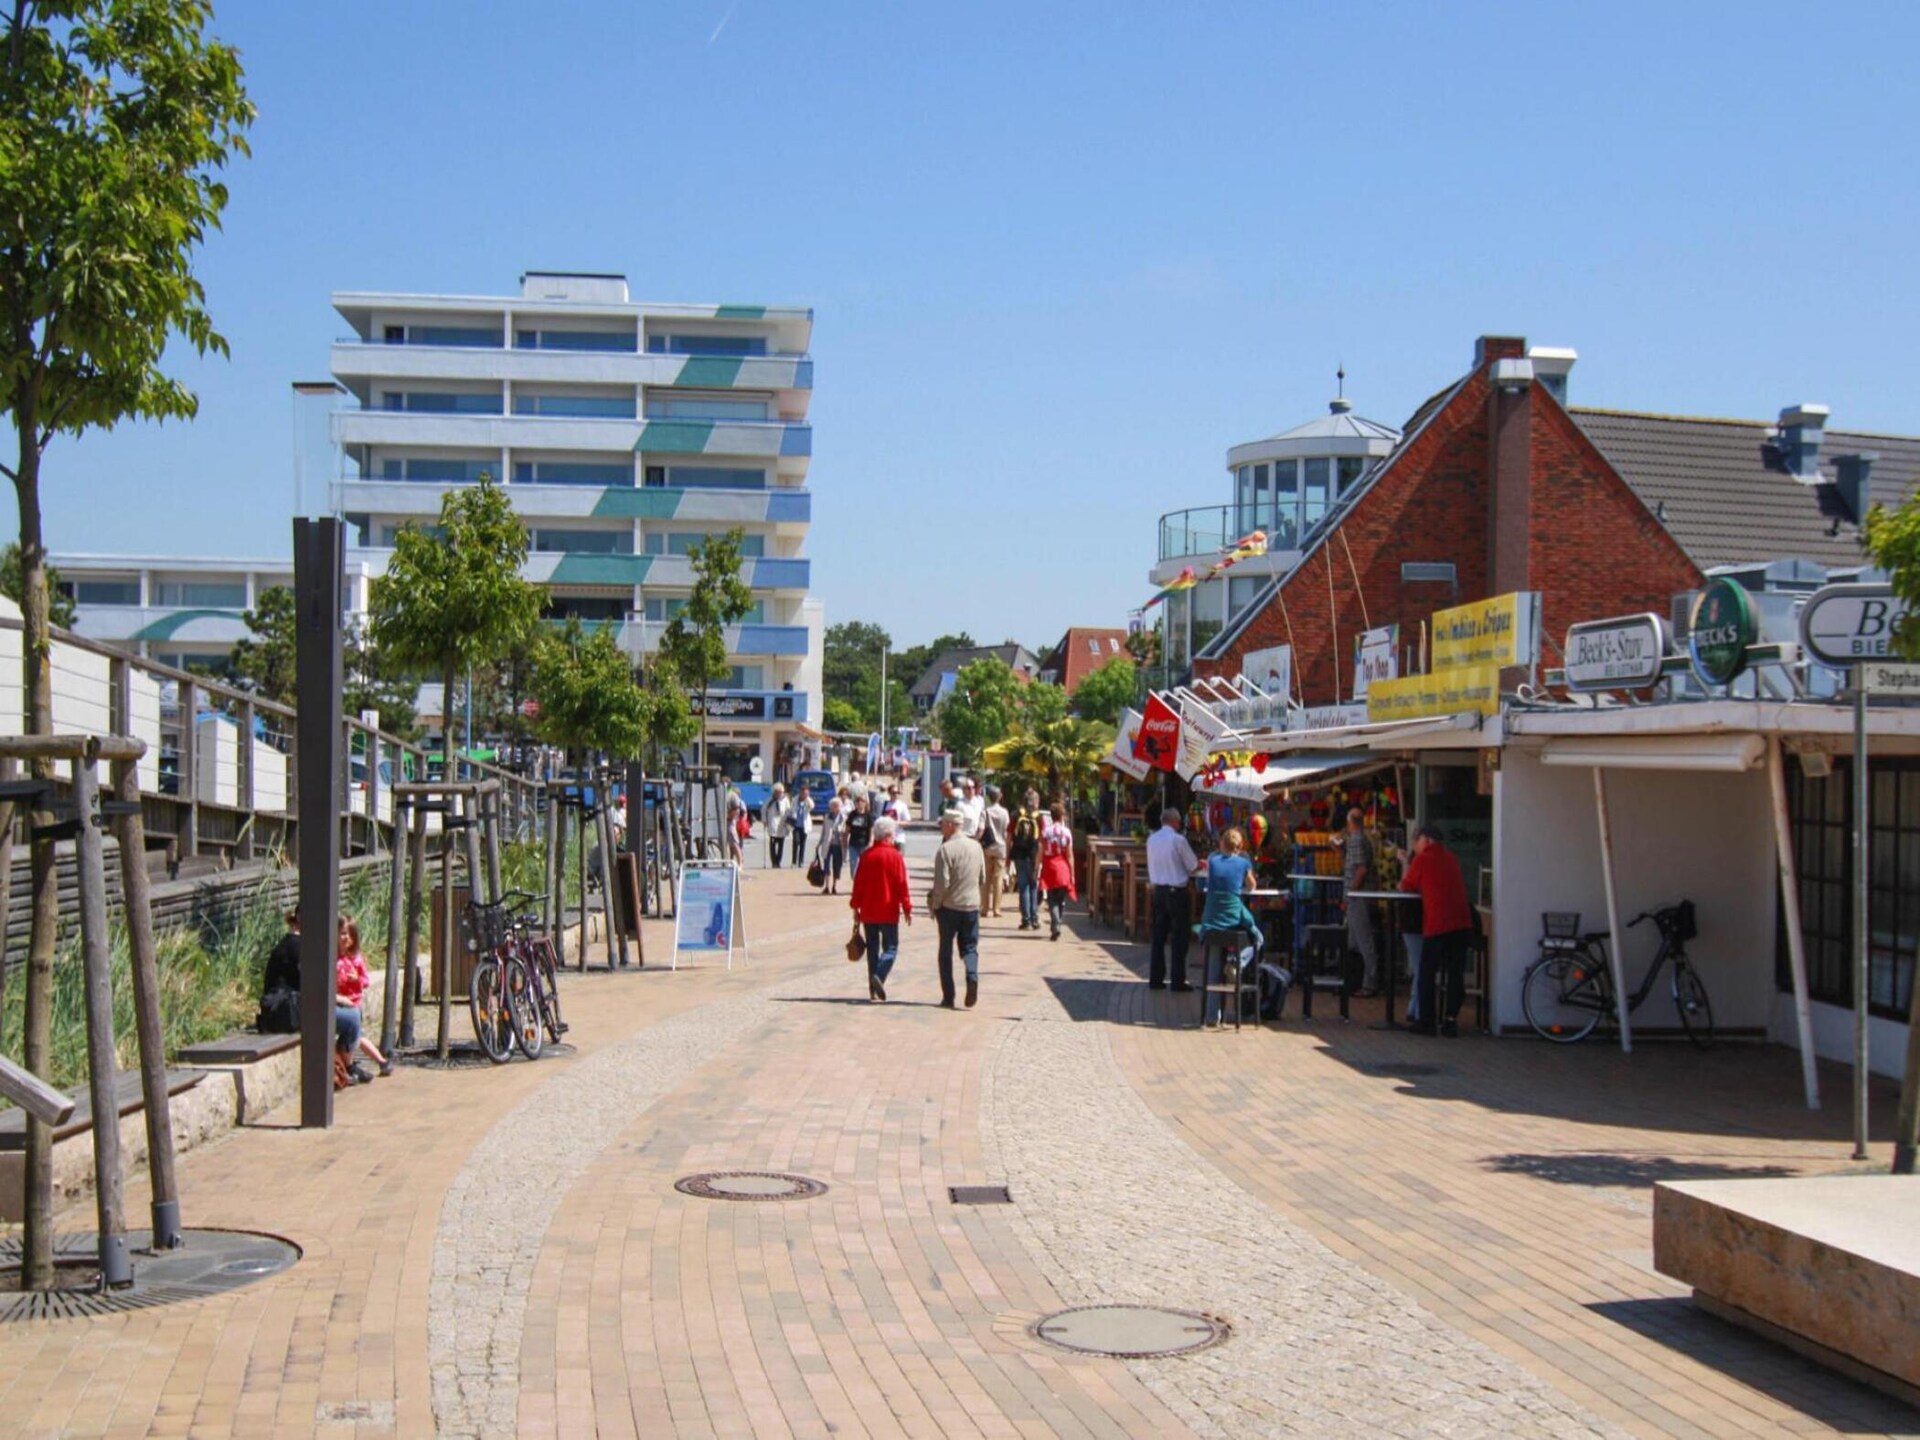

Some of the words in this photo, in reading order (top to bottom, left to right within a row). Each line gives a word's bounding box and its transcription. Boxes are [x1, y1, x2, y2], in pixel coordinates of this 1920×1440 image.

[1853, 600, 1909, 636] Be
[1852, 639, 1886, 654] BIE
[1878, 669, 1920, 690] Stepha
